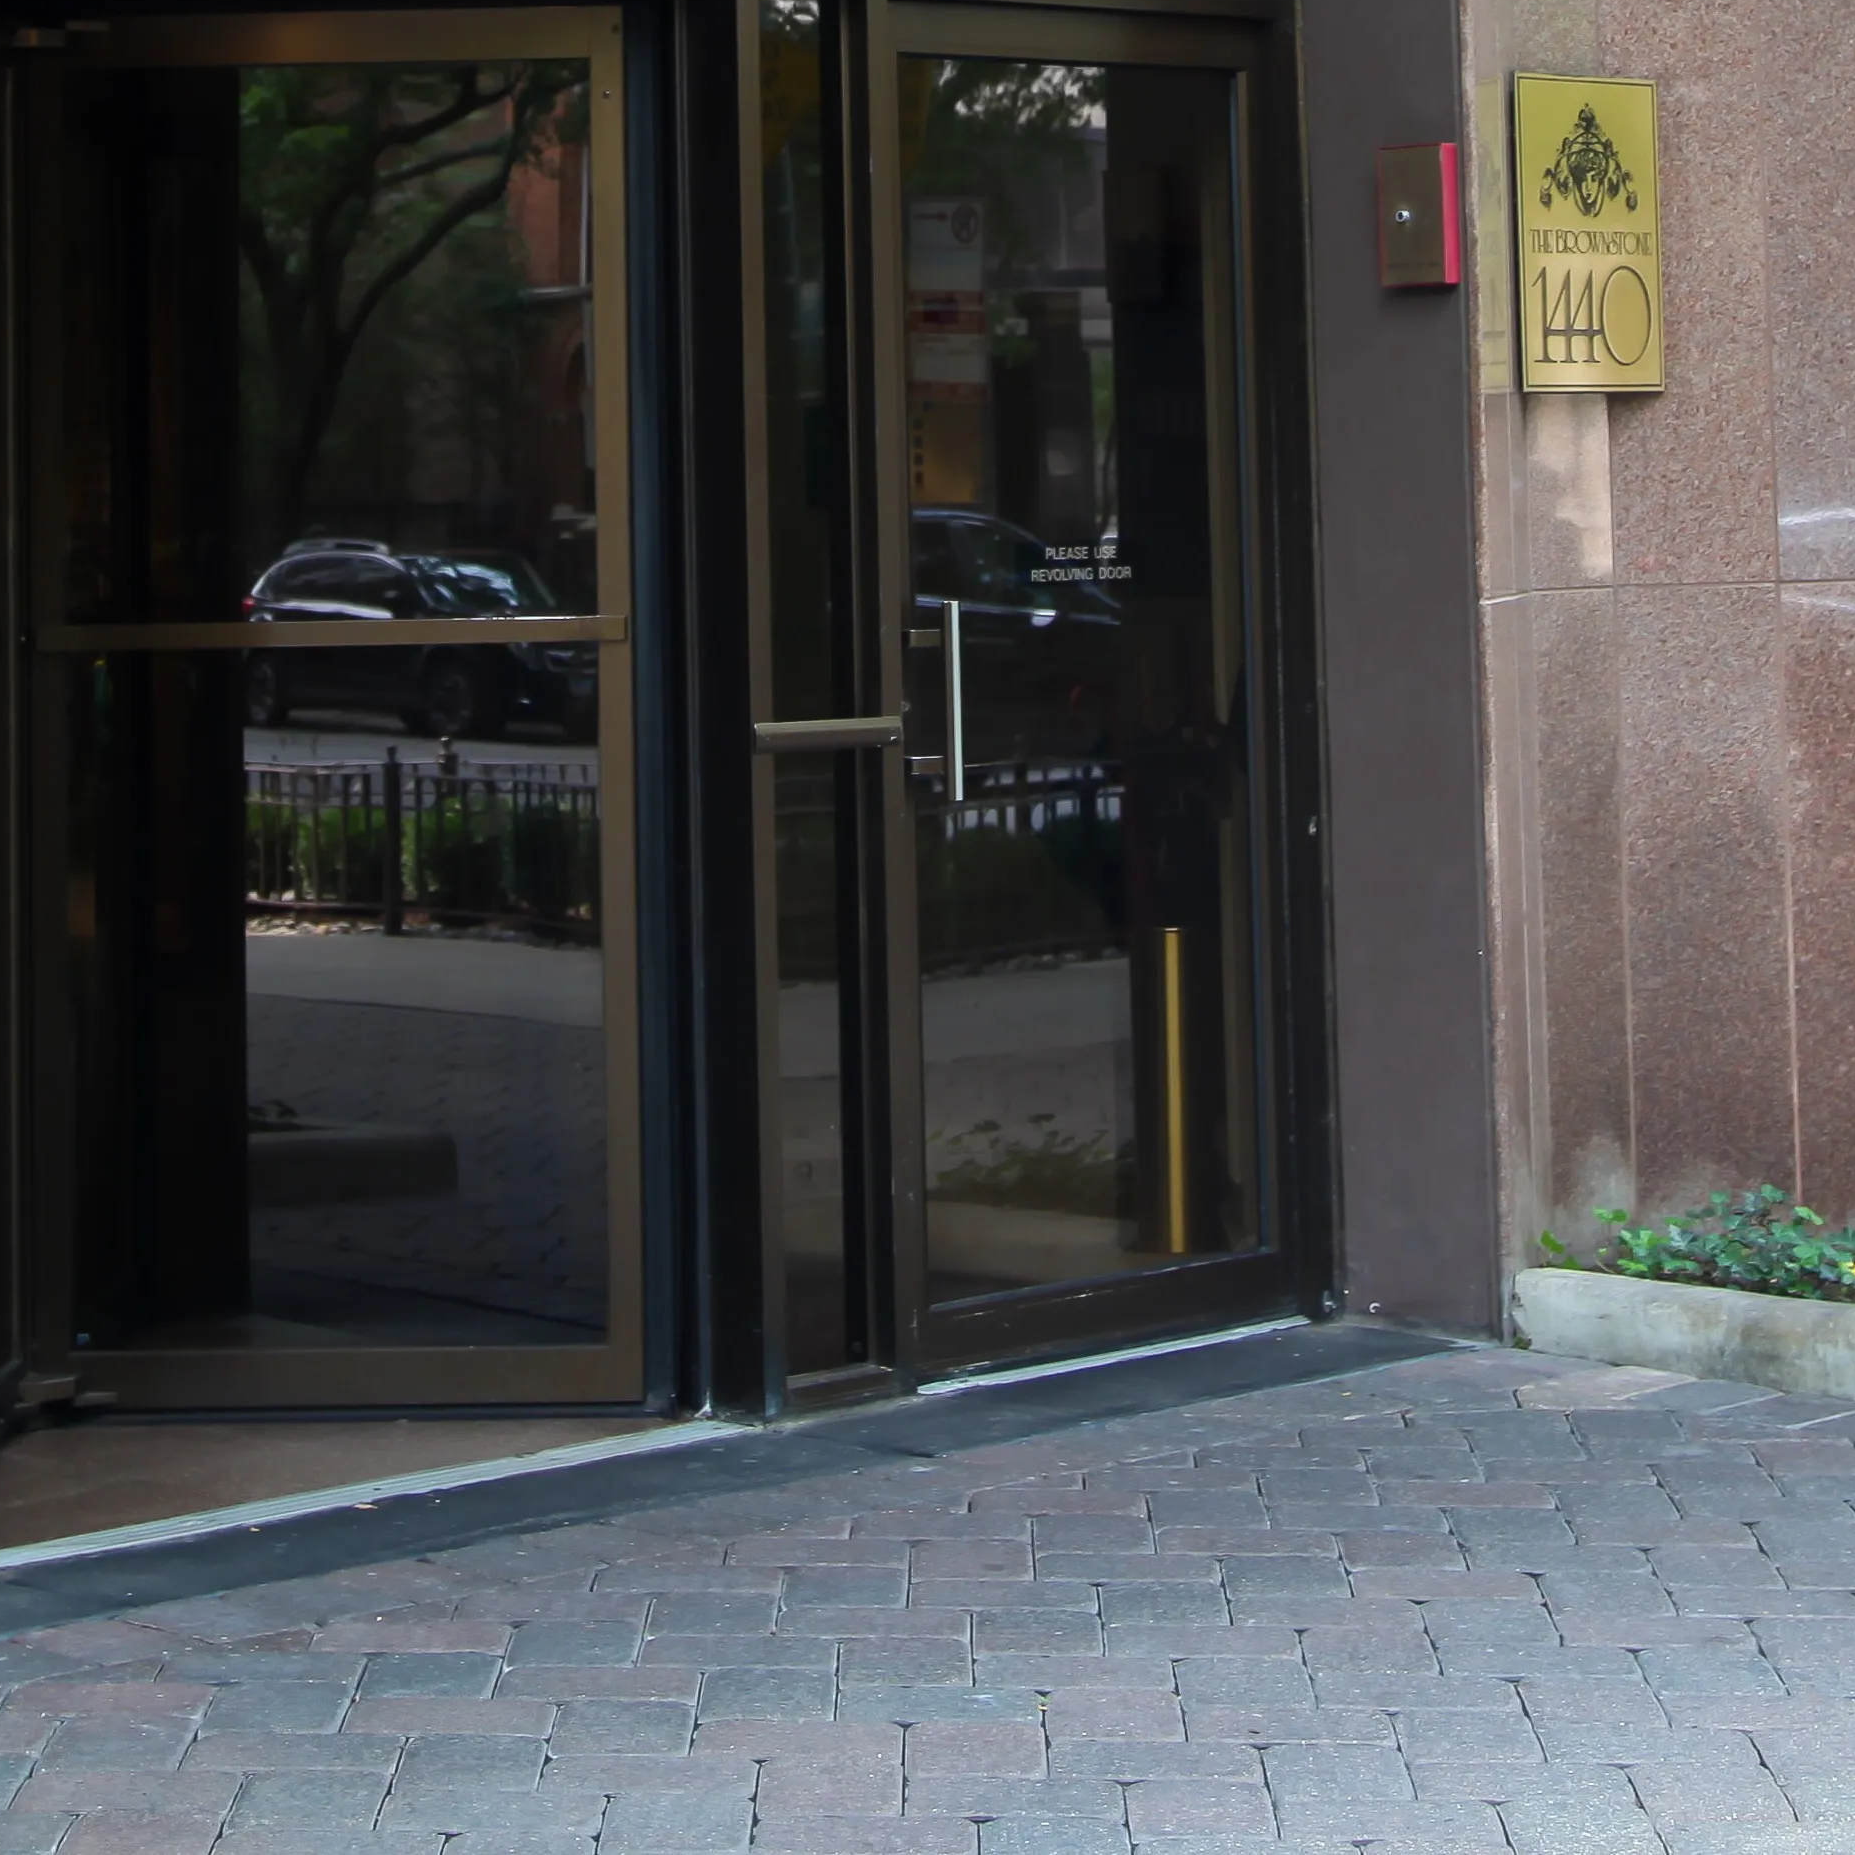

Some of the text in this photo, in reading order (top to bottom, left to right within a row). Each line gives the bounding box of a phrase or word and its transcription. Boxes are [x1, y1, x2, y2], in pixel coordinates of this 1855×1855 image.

[1530, 228, 1653, 257] THE BROWNSTONE
[1531, 265, 1652, 366] 1440
[1045, 546, 1117, 560] PLEASE USE
[1031, 566, 1132, 582] REVOLVING DOOR
